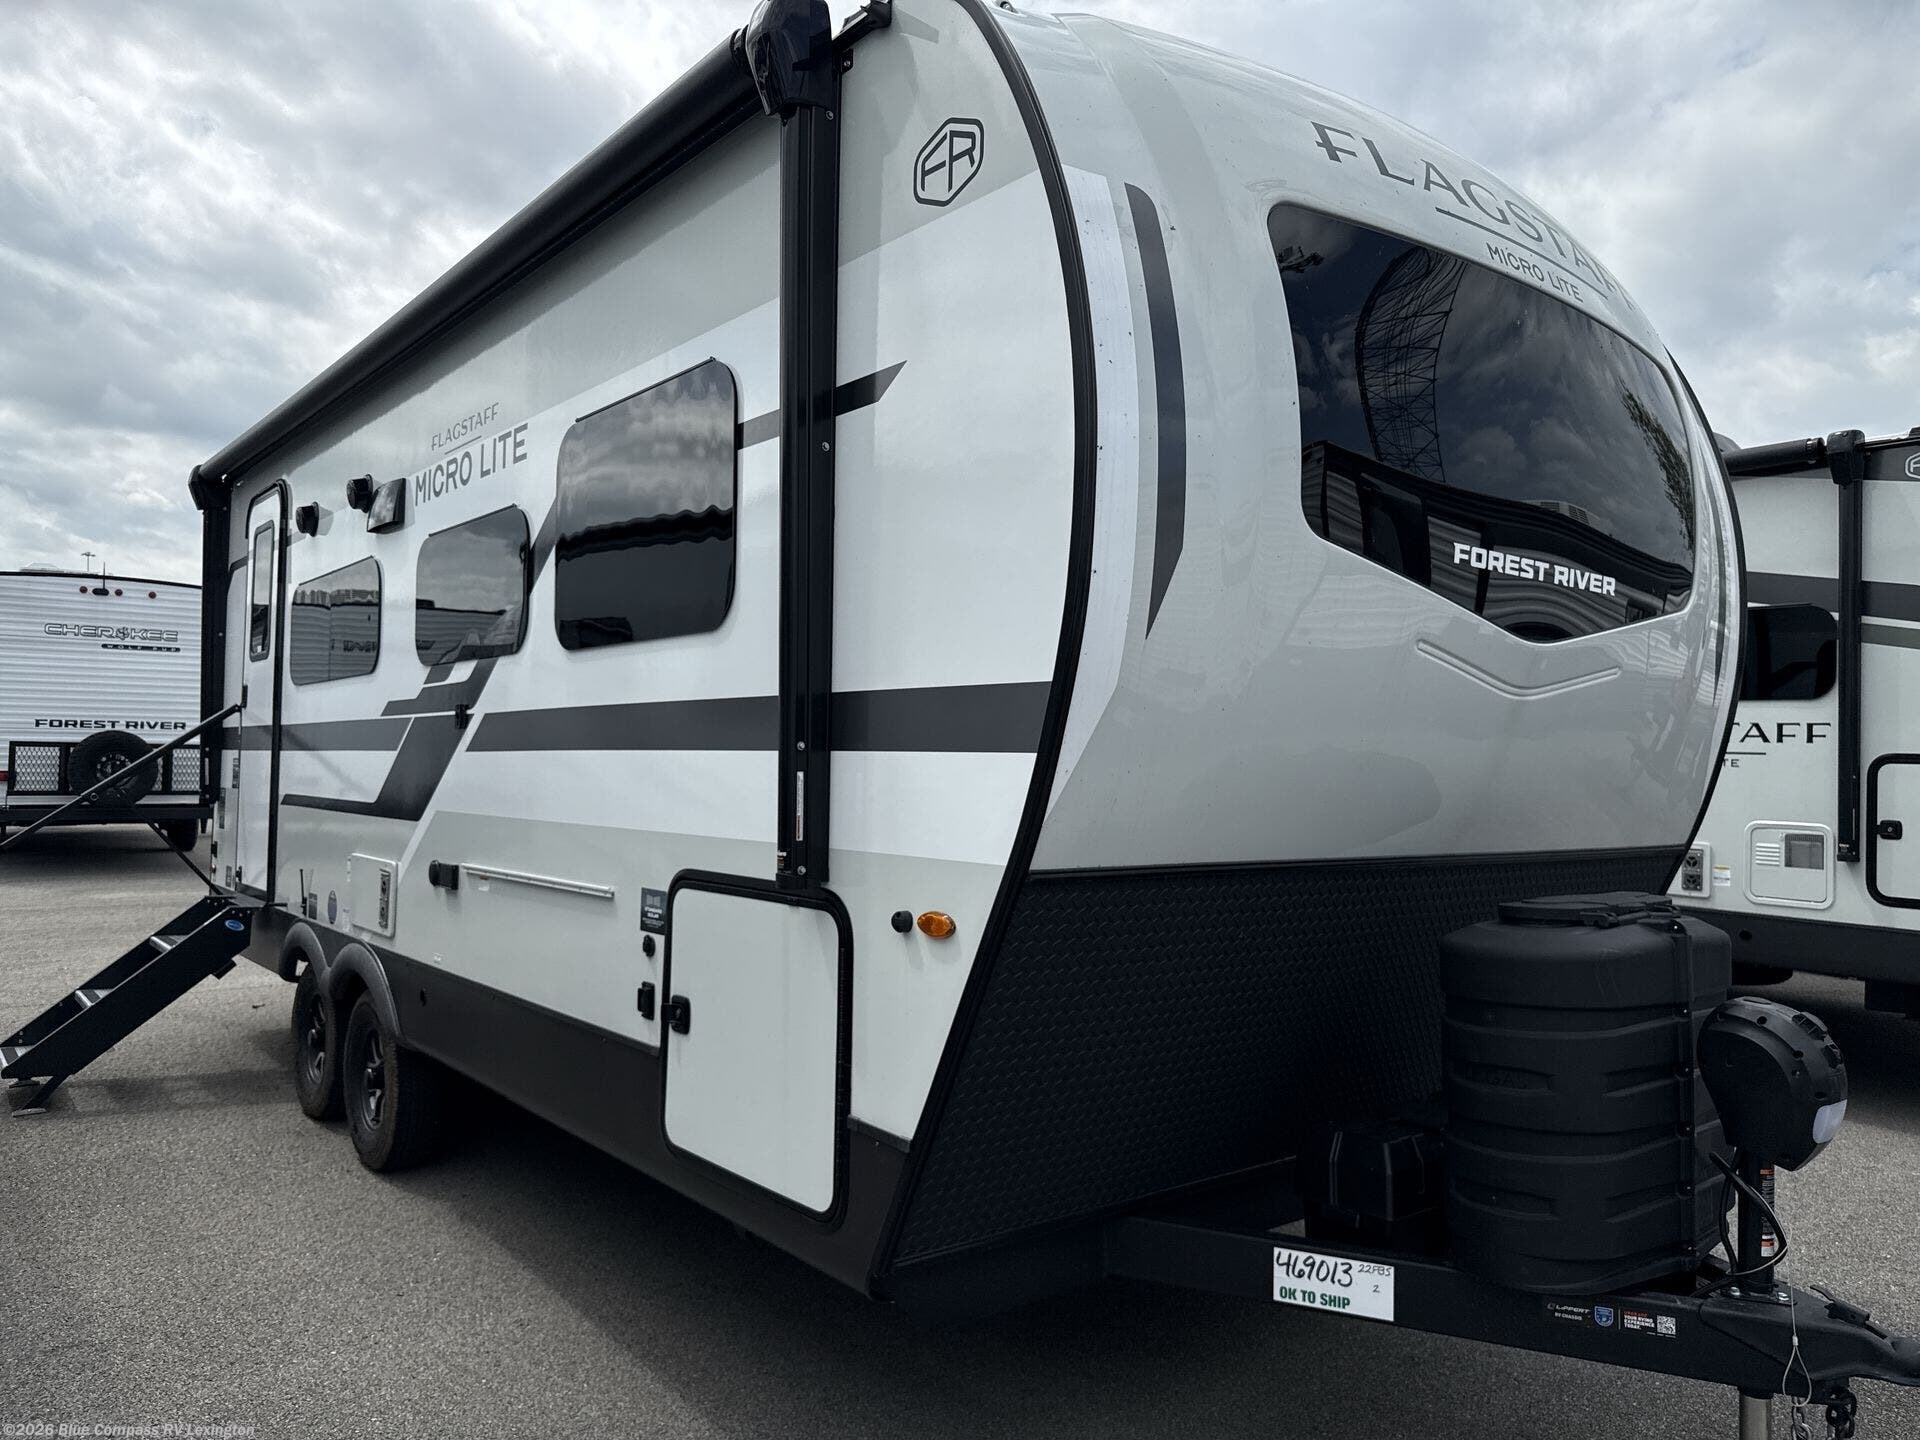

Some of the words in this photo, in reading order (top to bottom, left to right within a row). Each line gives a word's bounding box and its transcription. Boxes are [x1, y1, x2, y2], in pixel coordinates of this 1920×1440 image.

[1485, 242, 1545, 283] MICRO
[1548, 270, 1584, 303] LITE
[431, 402, 500, 451] FLAGSTAFF
[415, 450, 473, 507] MICRO
[480, 422, 529, 479] LITE
[1453, 542, 1550, 582] FOREST
[1553, 564, 1616, 597] RIVER
[44, 623, 179, 642] CHEROKEE
[34, 718, 120, 729] FOREST
[125, 720, 187, 730] RIVER
[1276, 1250, 1353, 1288] 469013
[1280, 1286, 1298, 1300] OK
[1301, 1289, 1317, 1304] TO
[1320, 1293, 1351, 1309] SHIP
[1372, 1284, 1380, 1293] 2
